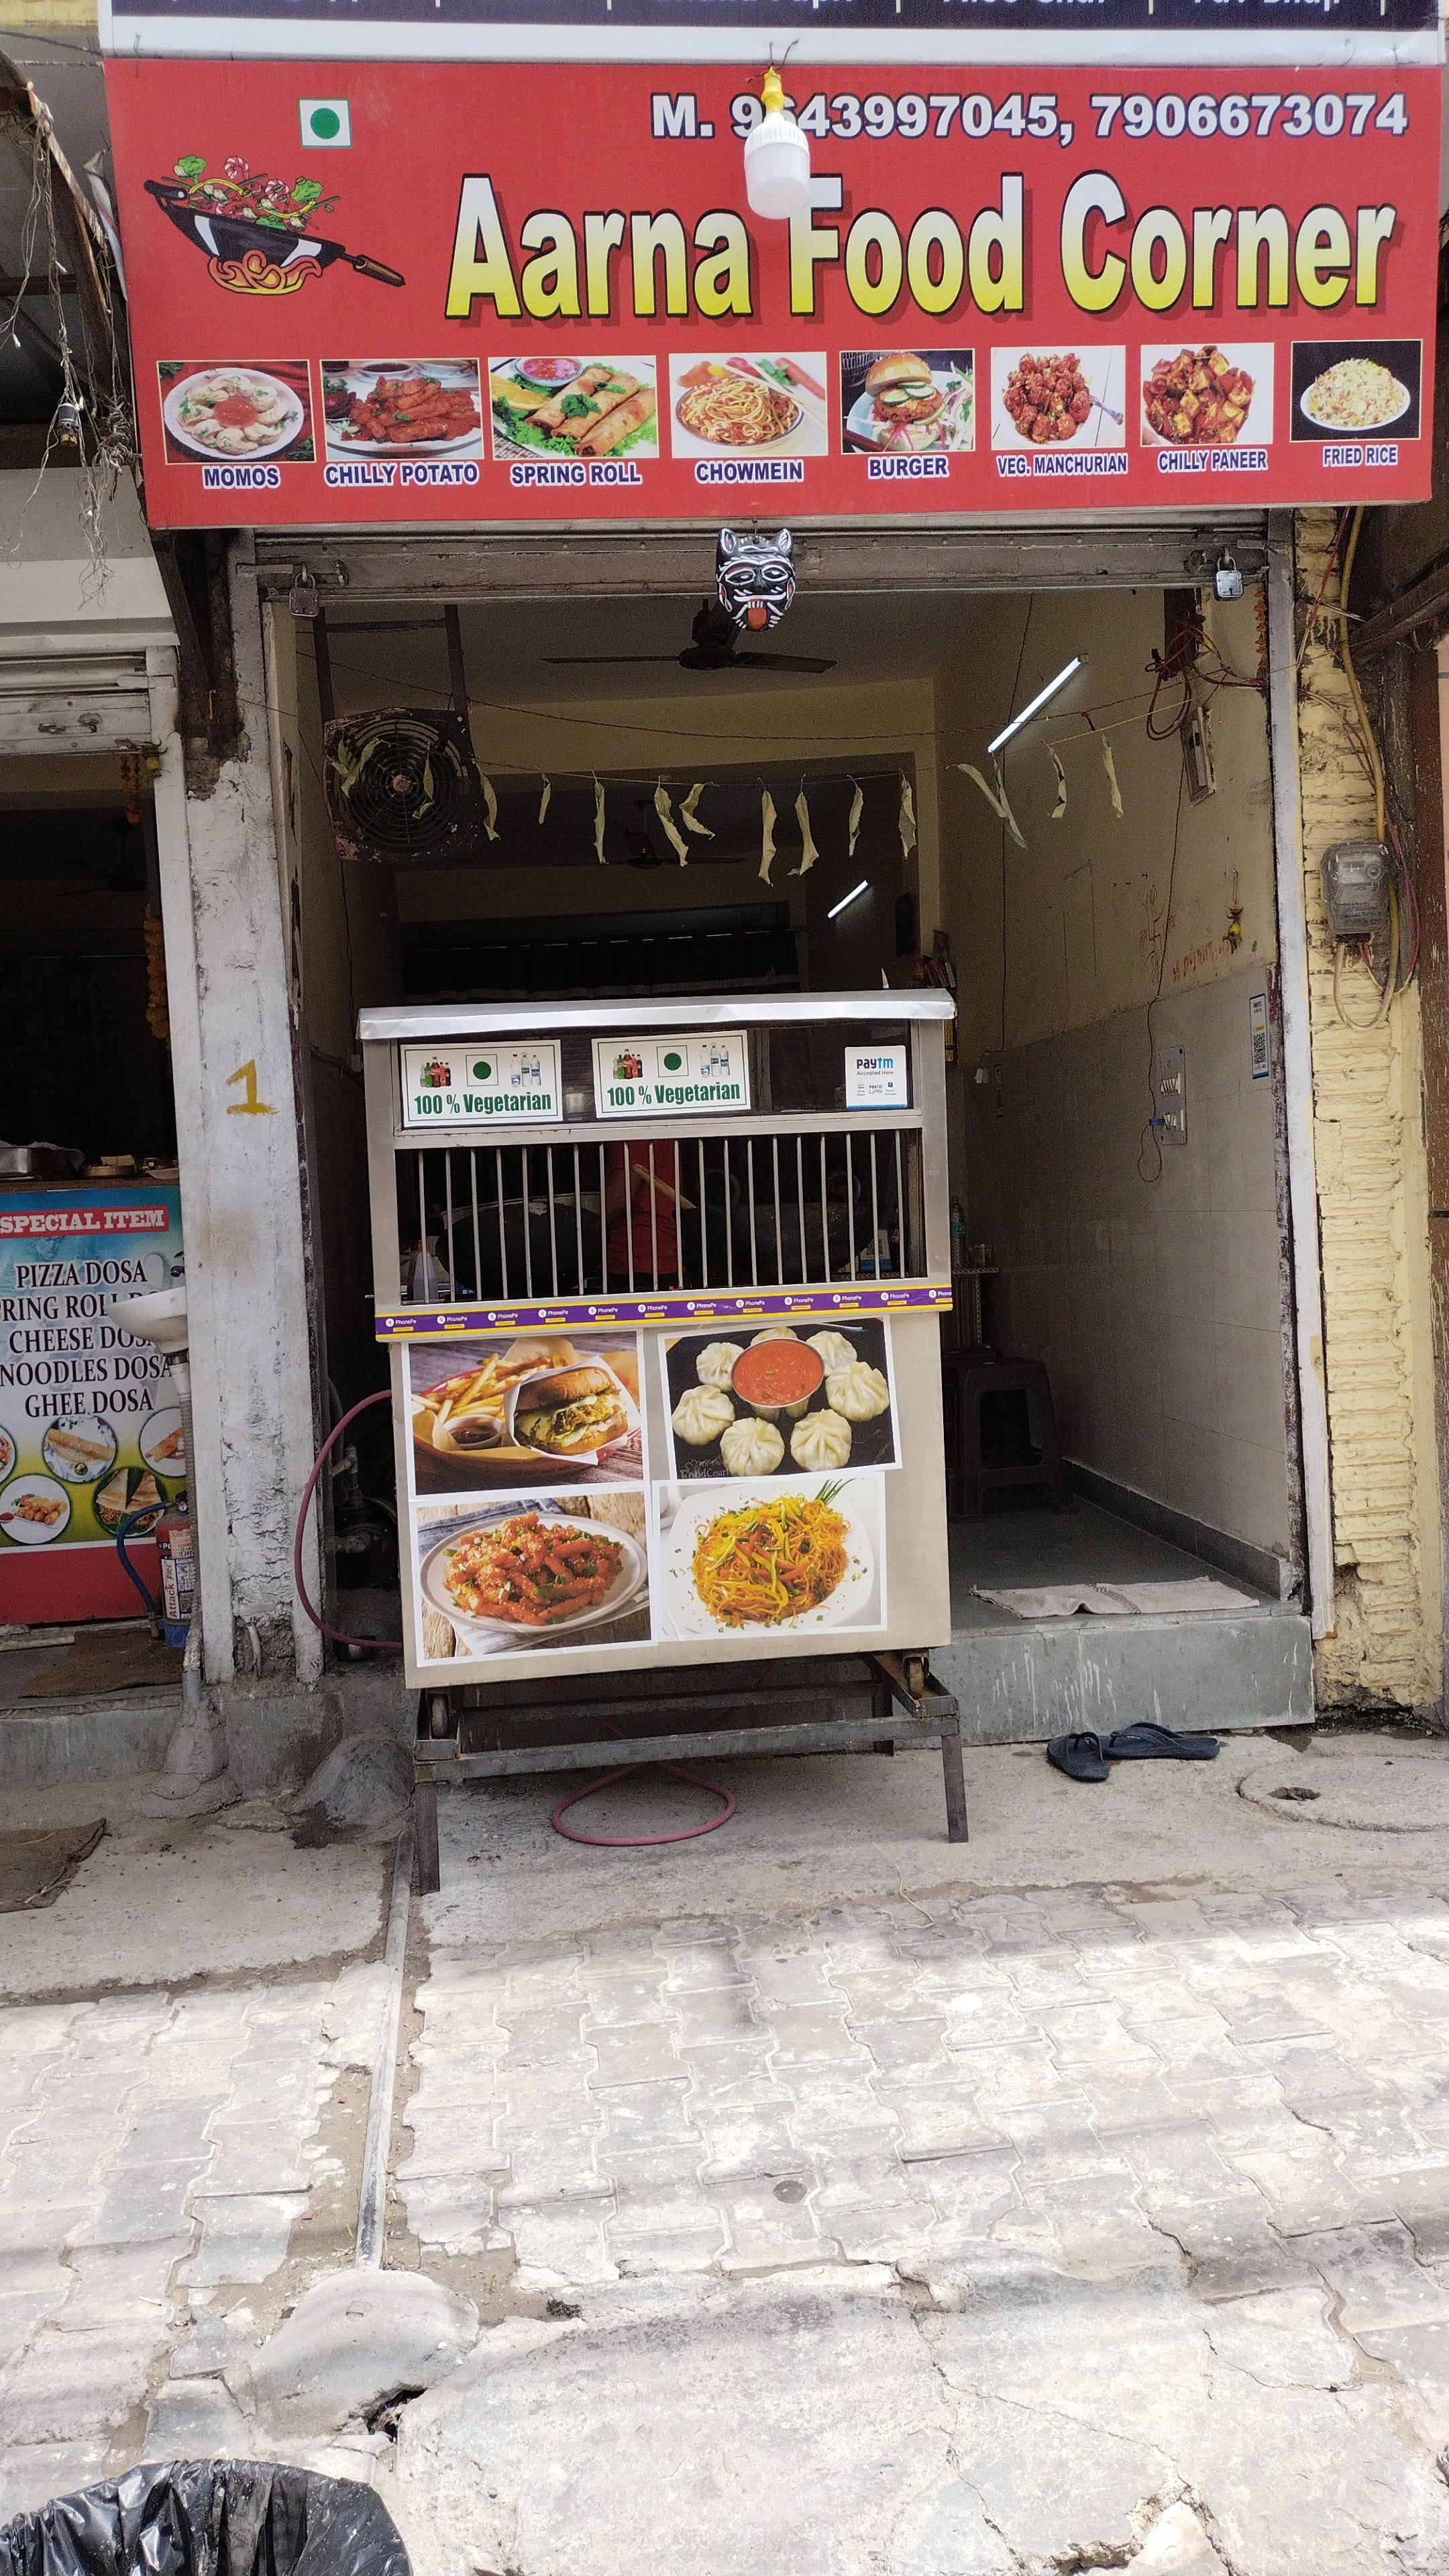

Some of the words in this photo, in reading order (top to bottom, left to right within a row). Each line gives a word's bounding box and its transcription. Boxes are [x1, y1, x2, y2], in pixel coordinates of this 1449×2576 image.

[651, 93, 713, 138] M.
[1090, 92, 1408, 139] 7906673074
[445, 173, 753, 319] Aarna
[788, 171, 1024, 317] Food
[1060, 169, 1397, 314] Corner
[869, 456, 948, 478] BURGER
[996, 456, 1031, 476] VEG.
[1034, 453, 1128, 474] MANCHURIAN
[1159, 450, 1207, 472] CHILLY
[1212, 450, 1268, 470] PANEER
[1323, 446, 1363, 466] FRIED
[1366, 445, 1397, 465] RICE
[202, 467, 280, 488] MOMOS
[325, 464, 396, 486] CHILLY
[401, 464, 479, 485] POTATO
[512, 464, 591, 485] SPRING
[596, 463, 641, 484] ROLL
[696, 460, 804, 482] CHOWMEIN
[226, 1059, 282, 1116] 1
[607, 1087, 636, 1106] 100
[638, 1085, 652, 1106] %
[655, 1082, 741, 1106] Vegetarian
[414, 1095, 443, 1115] 100
[446, 1095, 460, 1114] %
[464, 1092, 551, 1115] Vegetarian
[0, 1212, 100, 1234] SPECIAL
[103, 1209, 164, 1229] ITEM
[16, 1263, 80, 1288] PIZZA
[85, 1260, 148, 1285] DOSA
[890, 1292, 910, 1300] PhonePe
[497, 1312, 518, 1320] PhonePe
[9, 1327, 94, 1354] CHEESE
[0, 1358, 107, 1387] NOODLES
[114, 1355, 172, 1381] DOSA
[25, 1392, 86, 1418] GHEE
[91, 1388, 154, 1414] DOSA
